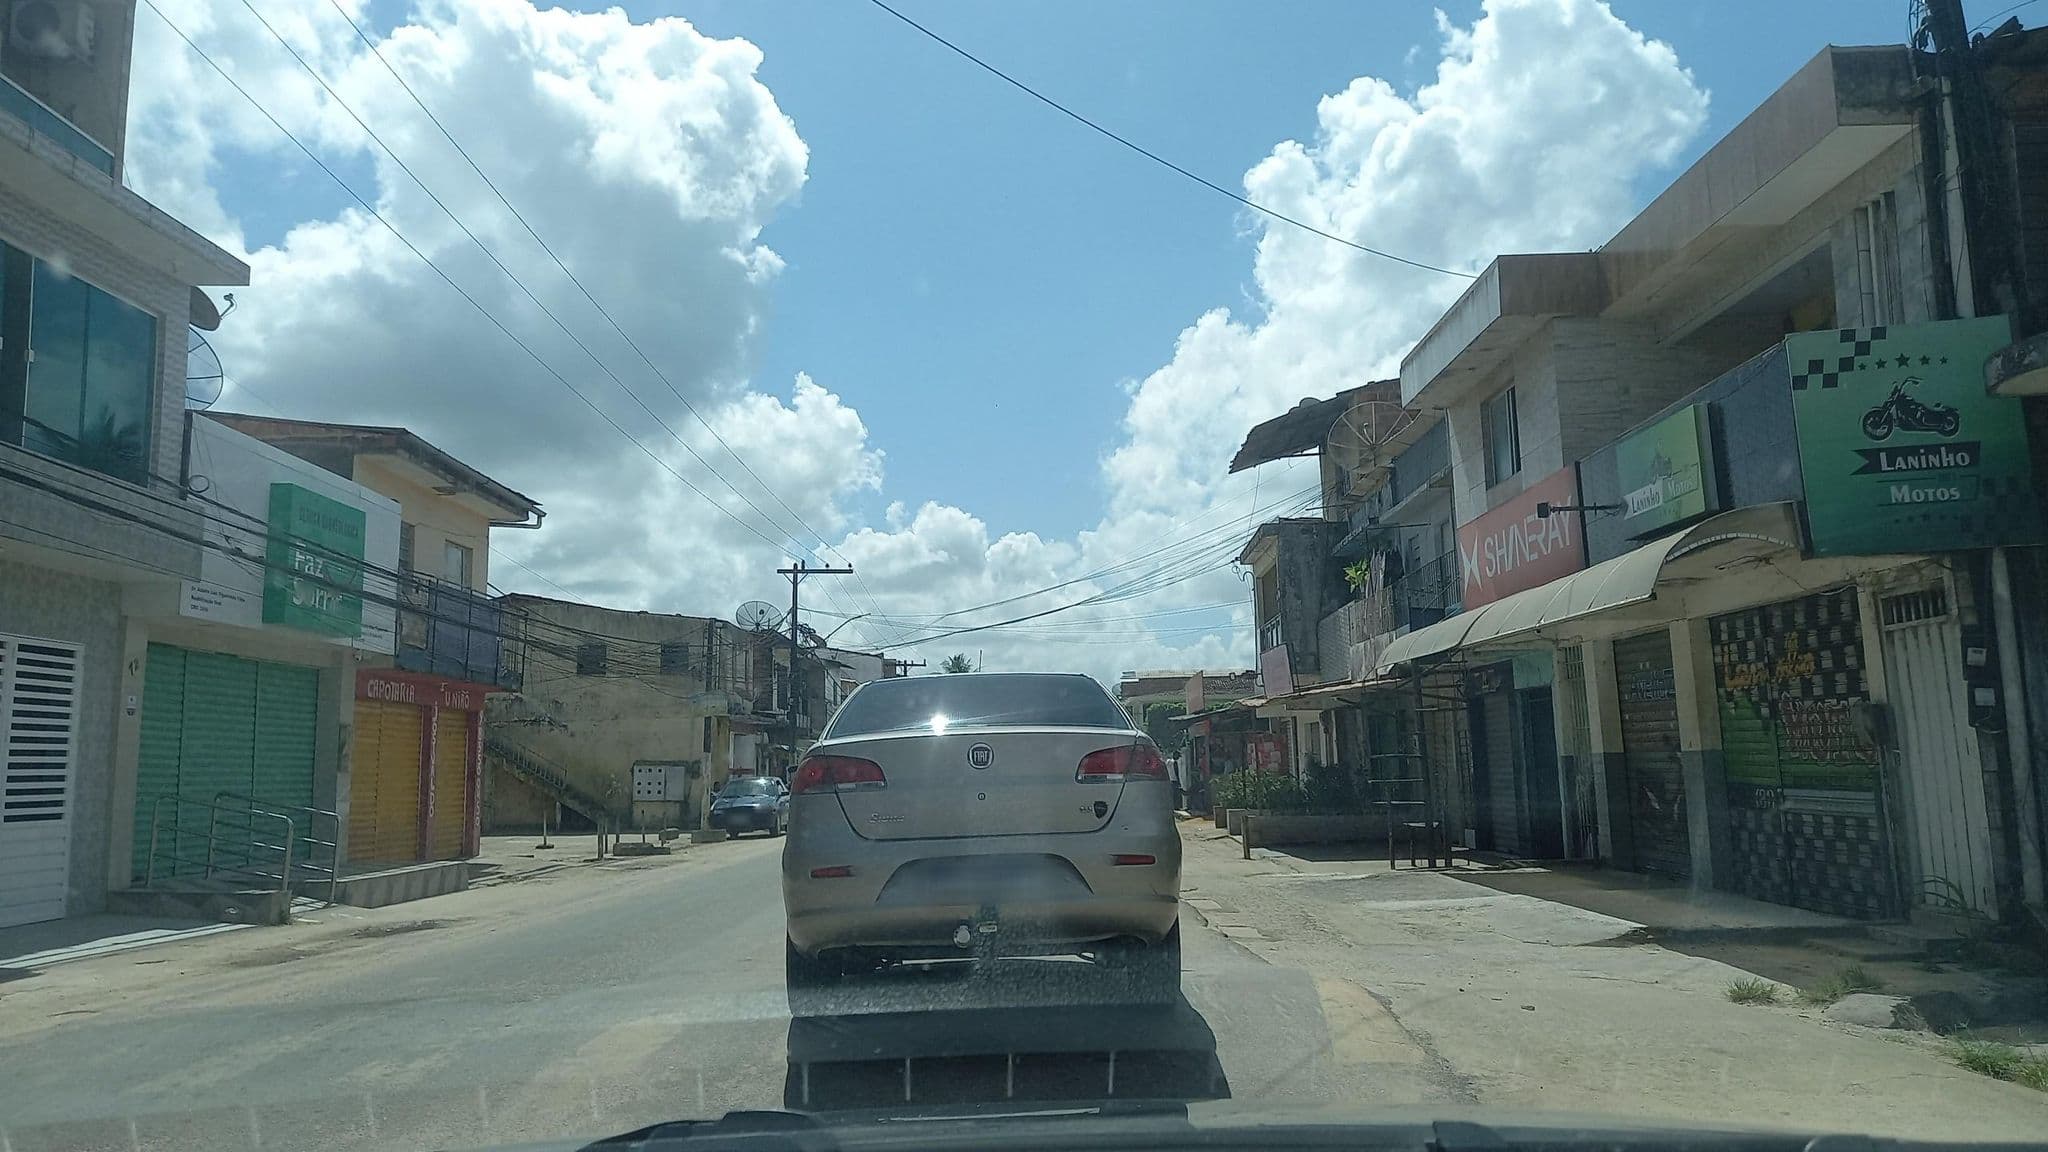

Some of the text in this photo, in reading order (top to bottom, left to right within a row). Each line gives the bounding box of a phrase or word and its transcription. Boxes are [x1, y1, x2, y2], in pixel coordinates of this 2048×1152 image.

[1890, 484, 1961, 504] MOTOS
[1484, 496, 1572, 578] SHINERAY
[294, 542, 325, 579] Faz
[367, 679, 415, 703] CAPOTARIA
[973, 750, 989, 763] FIAT
